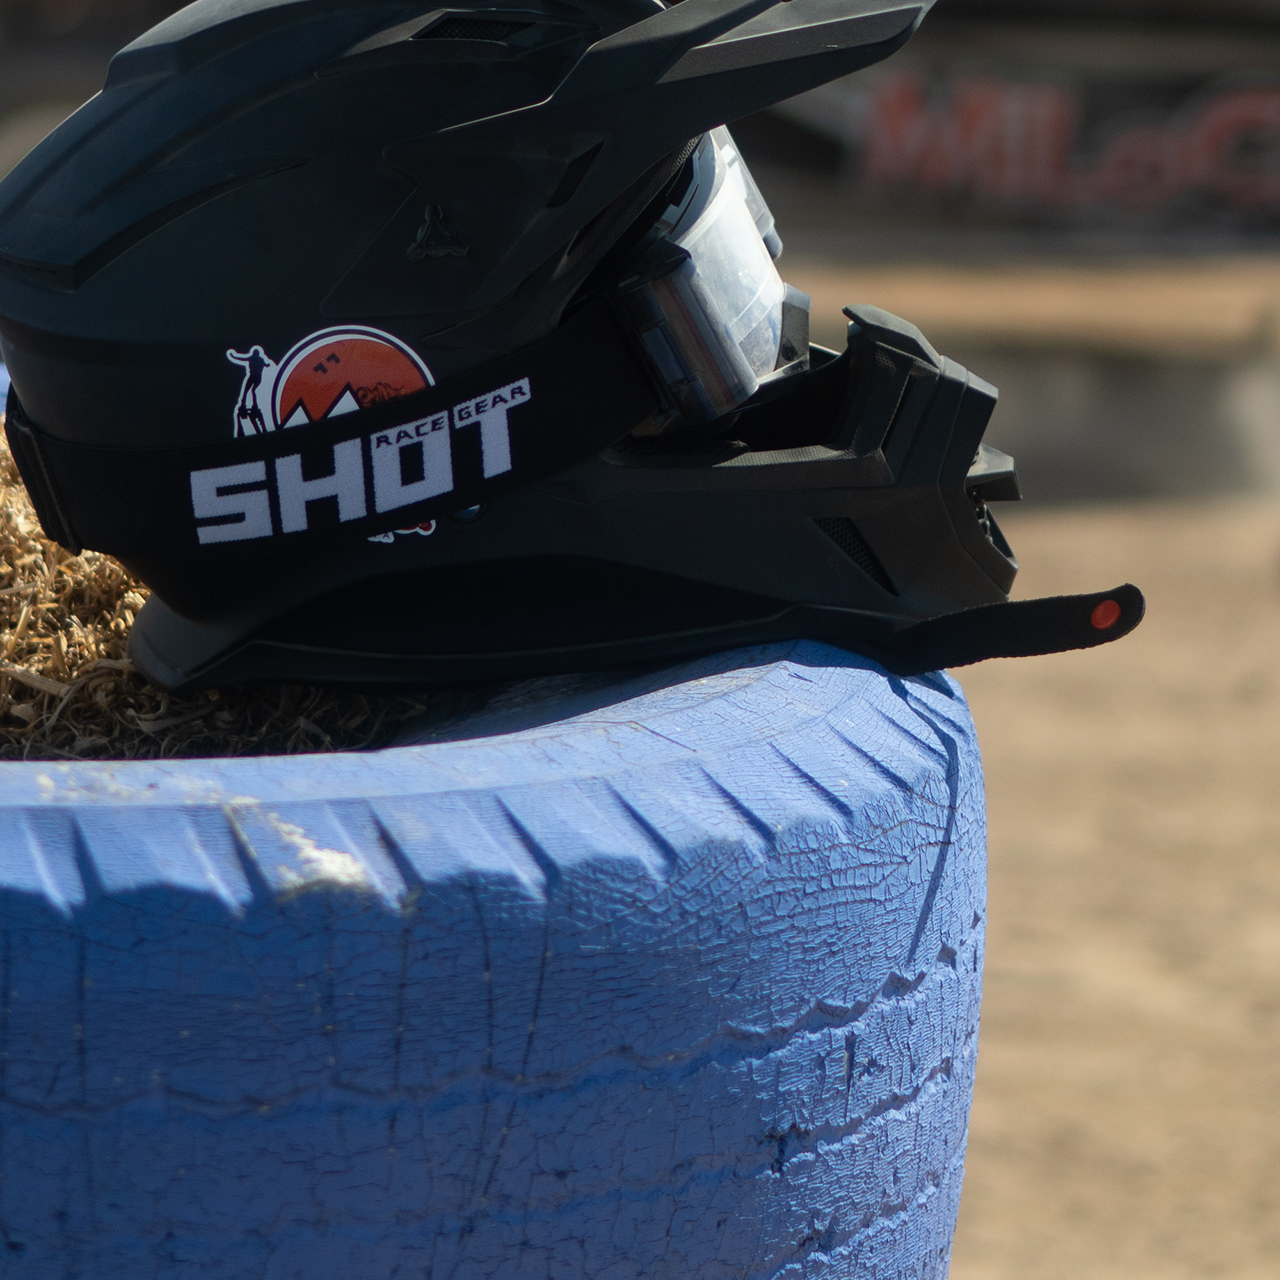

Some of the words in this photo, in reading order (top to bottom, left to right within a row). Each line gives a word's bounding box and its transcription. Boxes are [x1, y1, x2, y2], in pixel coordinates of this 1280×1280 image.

[190, 377, 531, 544] SHOT
[375, 415, 445, 449] RACE
[457, 384, 527, 422] GEAR
